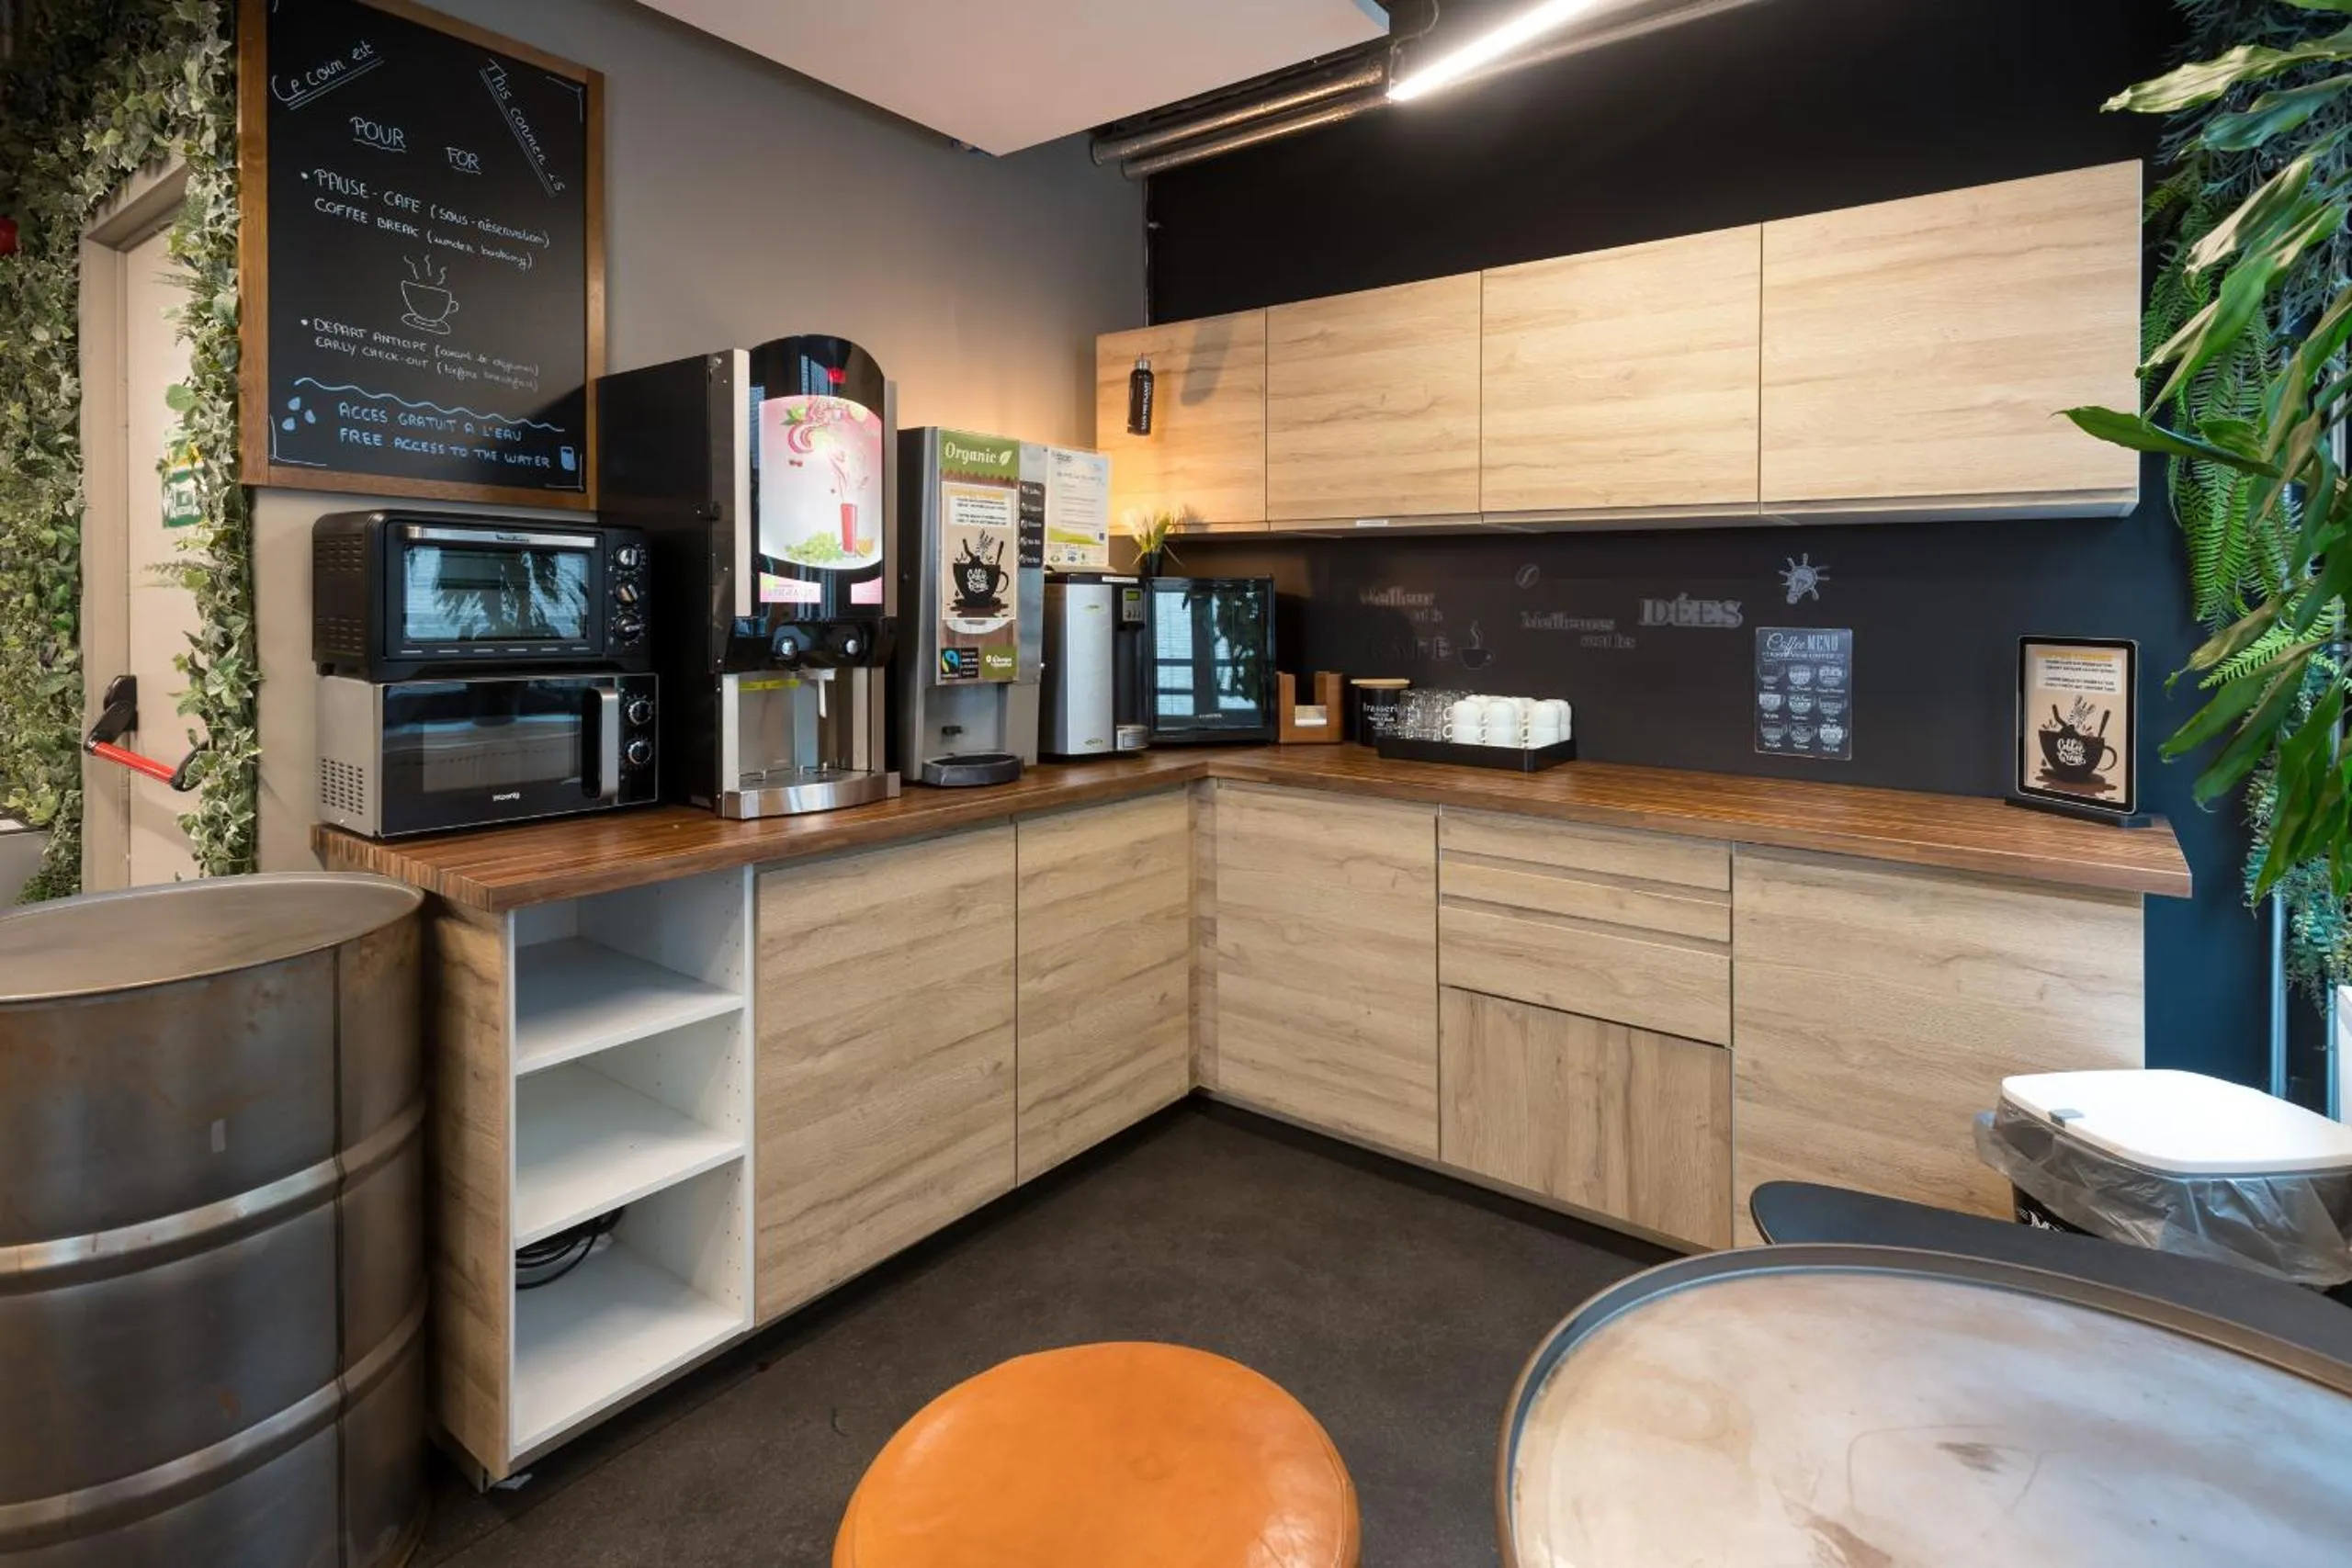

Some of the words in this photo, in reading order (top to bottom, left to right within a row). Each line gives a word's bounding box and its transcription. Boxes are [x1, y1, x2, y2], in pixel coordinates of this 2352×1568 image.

[305, 60, 346, 86] coin
[352, 39, 374, 61] est
[487, 57, 513, 100] This
[349, 116, 407, 148] POUR
[445, 146, 481, 171] FOR
[314, 197, 368, 224] COFFEE
[377, 217, 421, 239] BREAK
[314, 318, 368, 338] DEPART
[314, 336, 357, 357] EARLY
[339, 401, 388, 423] ACCES
[398, 412, 457, 434] GRATUIT
[464, 422, 475, 435] A
[482, 425, 522, 442] L'EAU
[339, 427, 383, 446] FREE
[394, 436, 446, 456] ACCESS
[448, 446, 468, 457] TO
[472, 447, 497, 462] THE
[503, 452, 551, 469] WATER
[944, 441, 997, 465] Organic
[1766, 632, 1806, 659] Coffee
